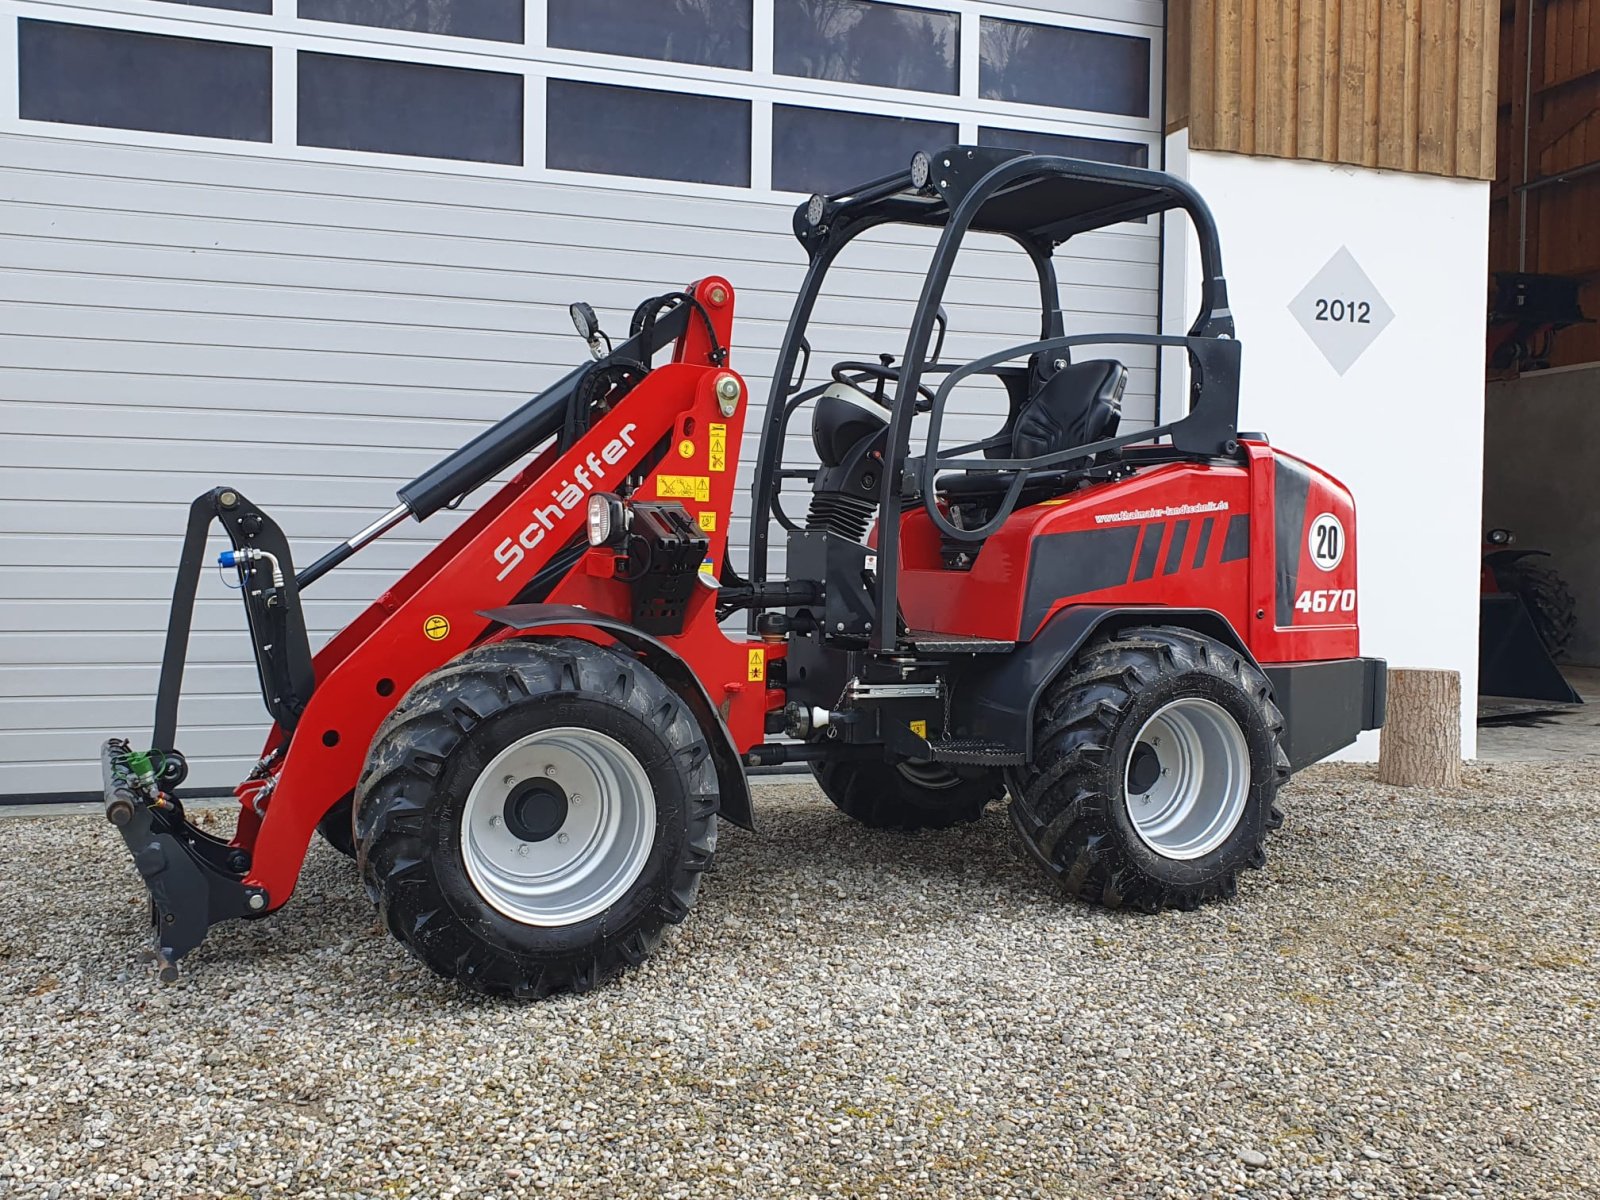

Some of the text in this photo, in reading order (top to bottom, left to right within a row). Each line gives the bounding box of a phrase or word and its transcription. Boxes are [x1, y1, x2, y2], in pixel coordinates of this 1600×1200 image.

[1315, 298, 1371, 324] 2012
[493, 423, 637, 582] Schäffer
[1316, 524, 1338, 560] 20
[1295, 589, 1356, 613] 4670
